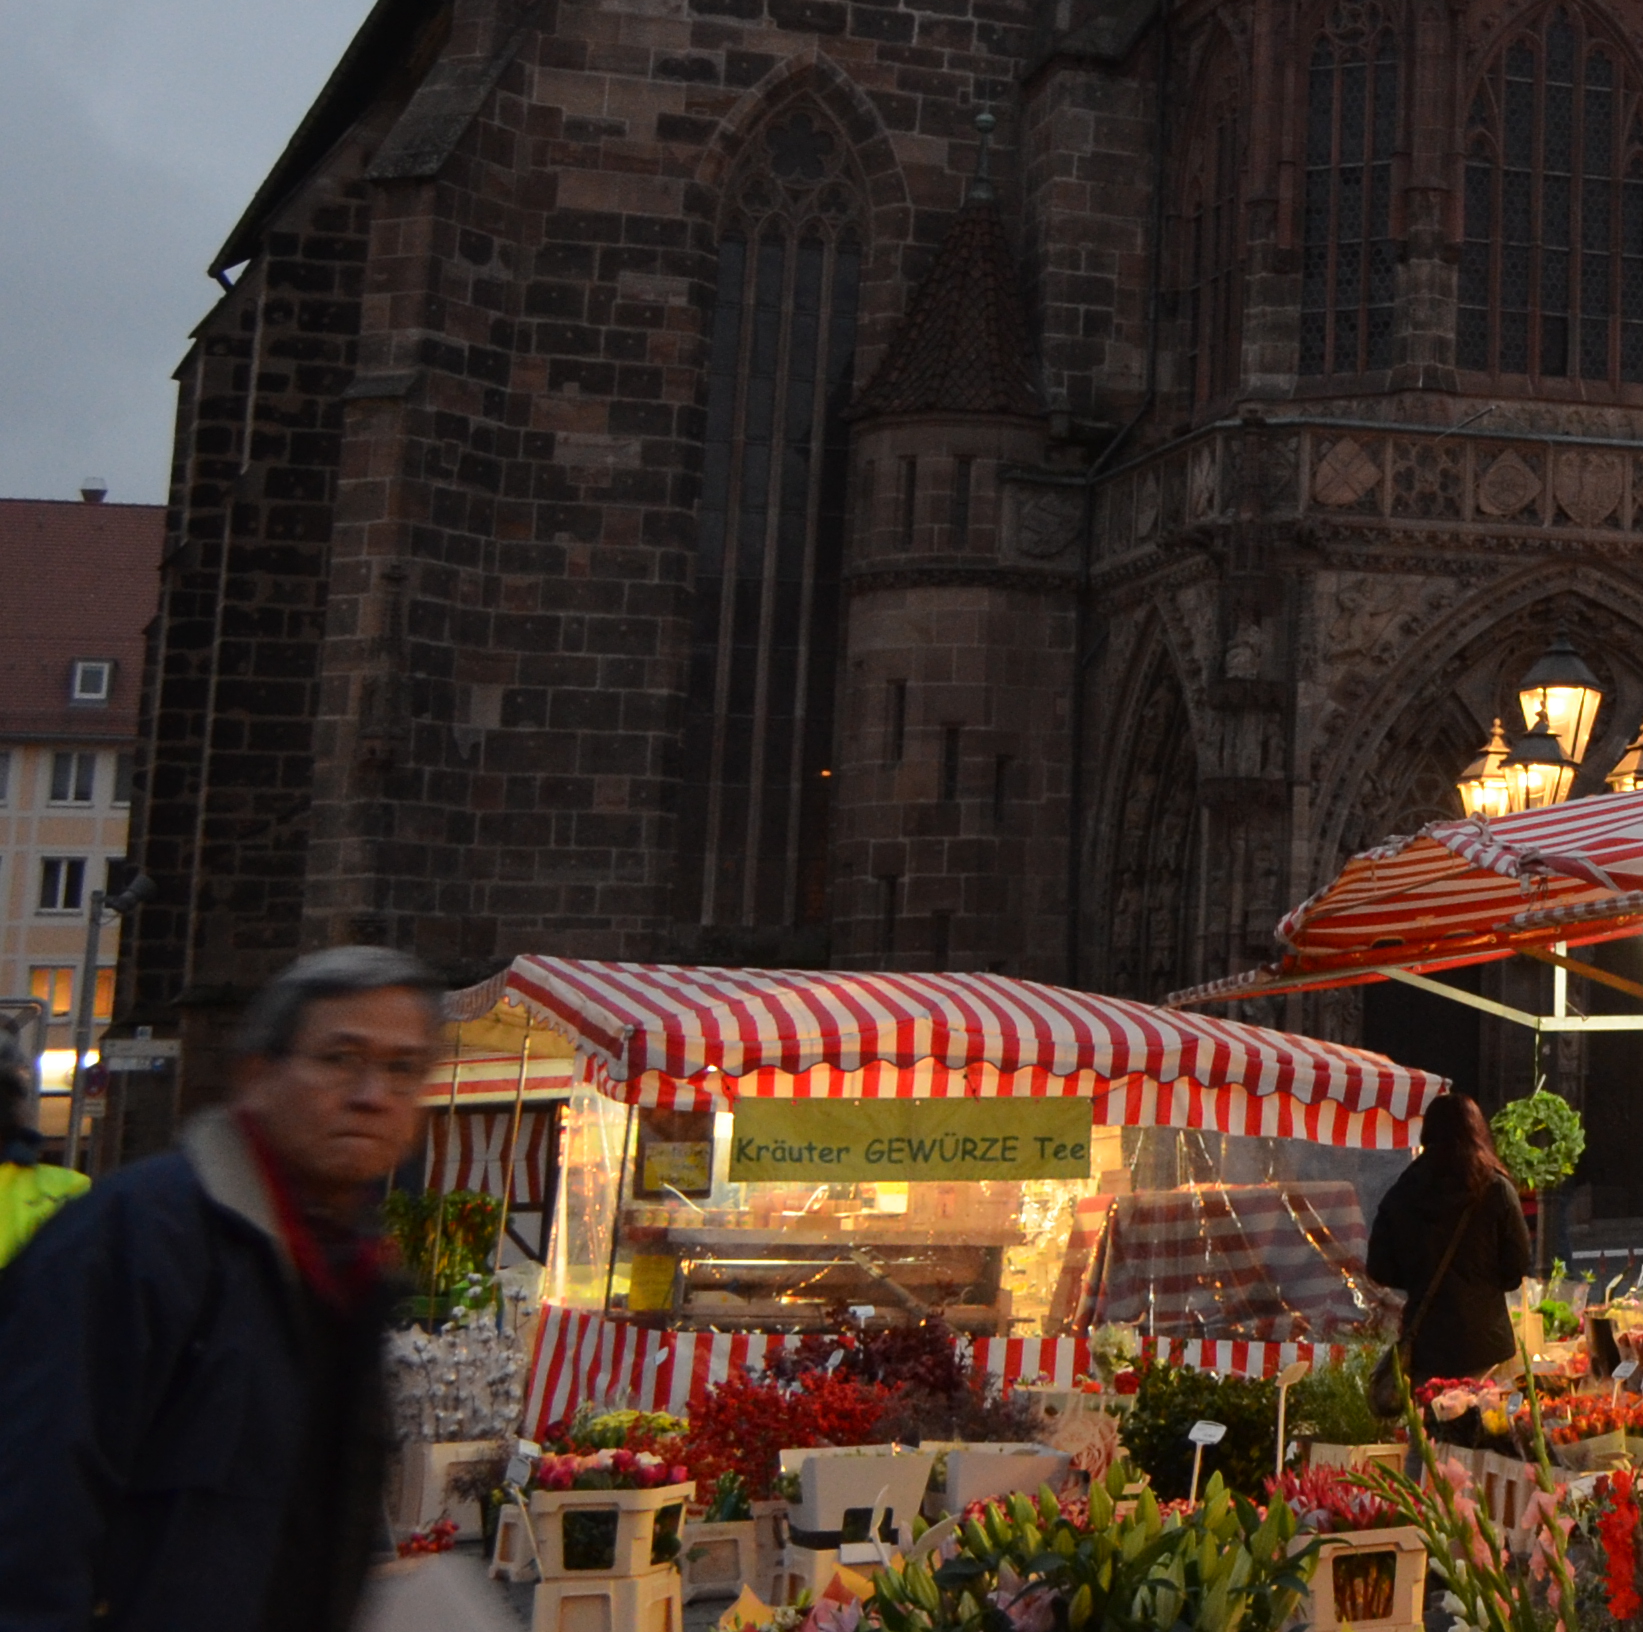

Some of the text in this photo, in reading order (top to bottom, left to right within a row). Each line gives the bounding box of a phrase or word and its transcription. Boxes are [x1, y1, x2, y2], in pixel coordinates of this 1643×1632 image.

[736, 1135, 850, 1164] Kräuter
[865, 1131, 1019, 1164] GEWÜRZE
[1033, 1136, 1086, 1162] Tee
